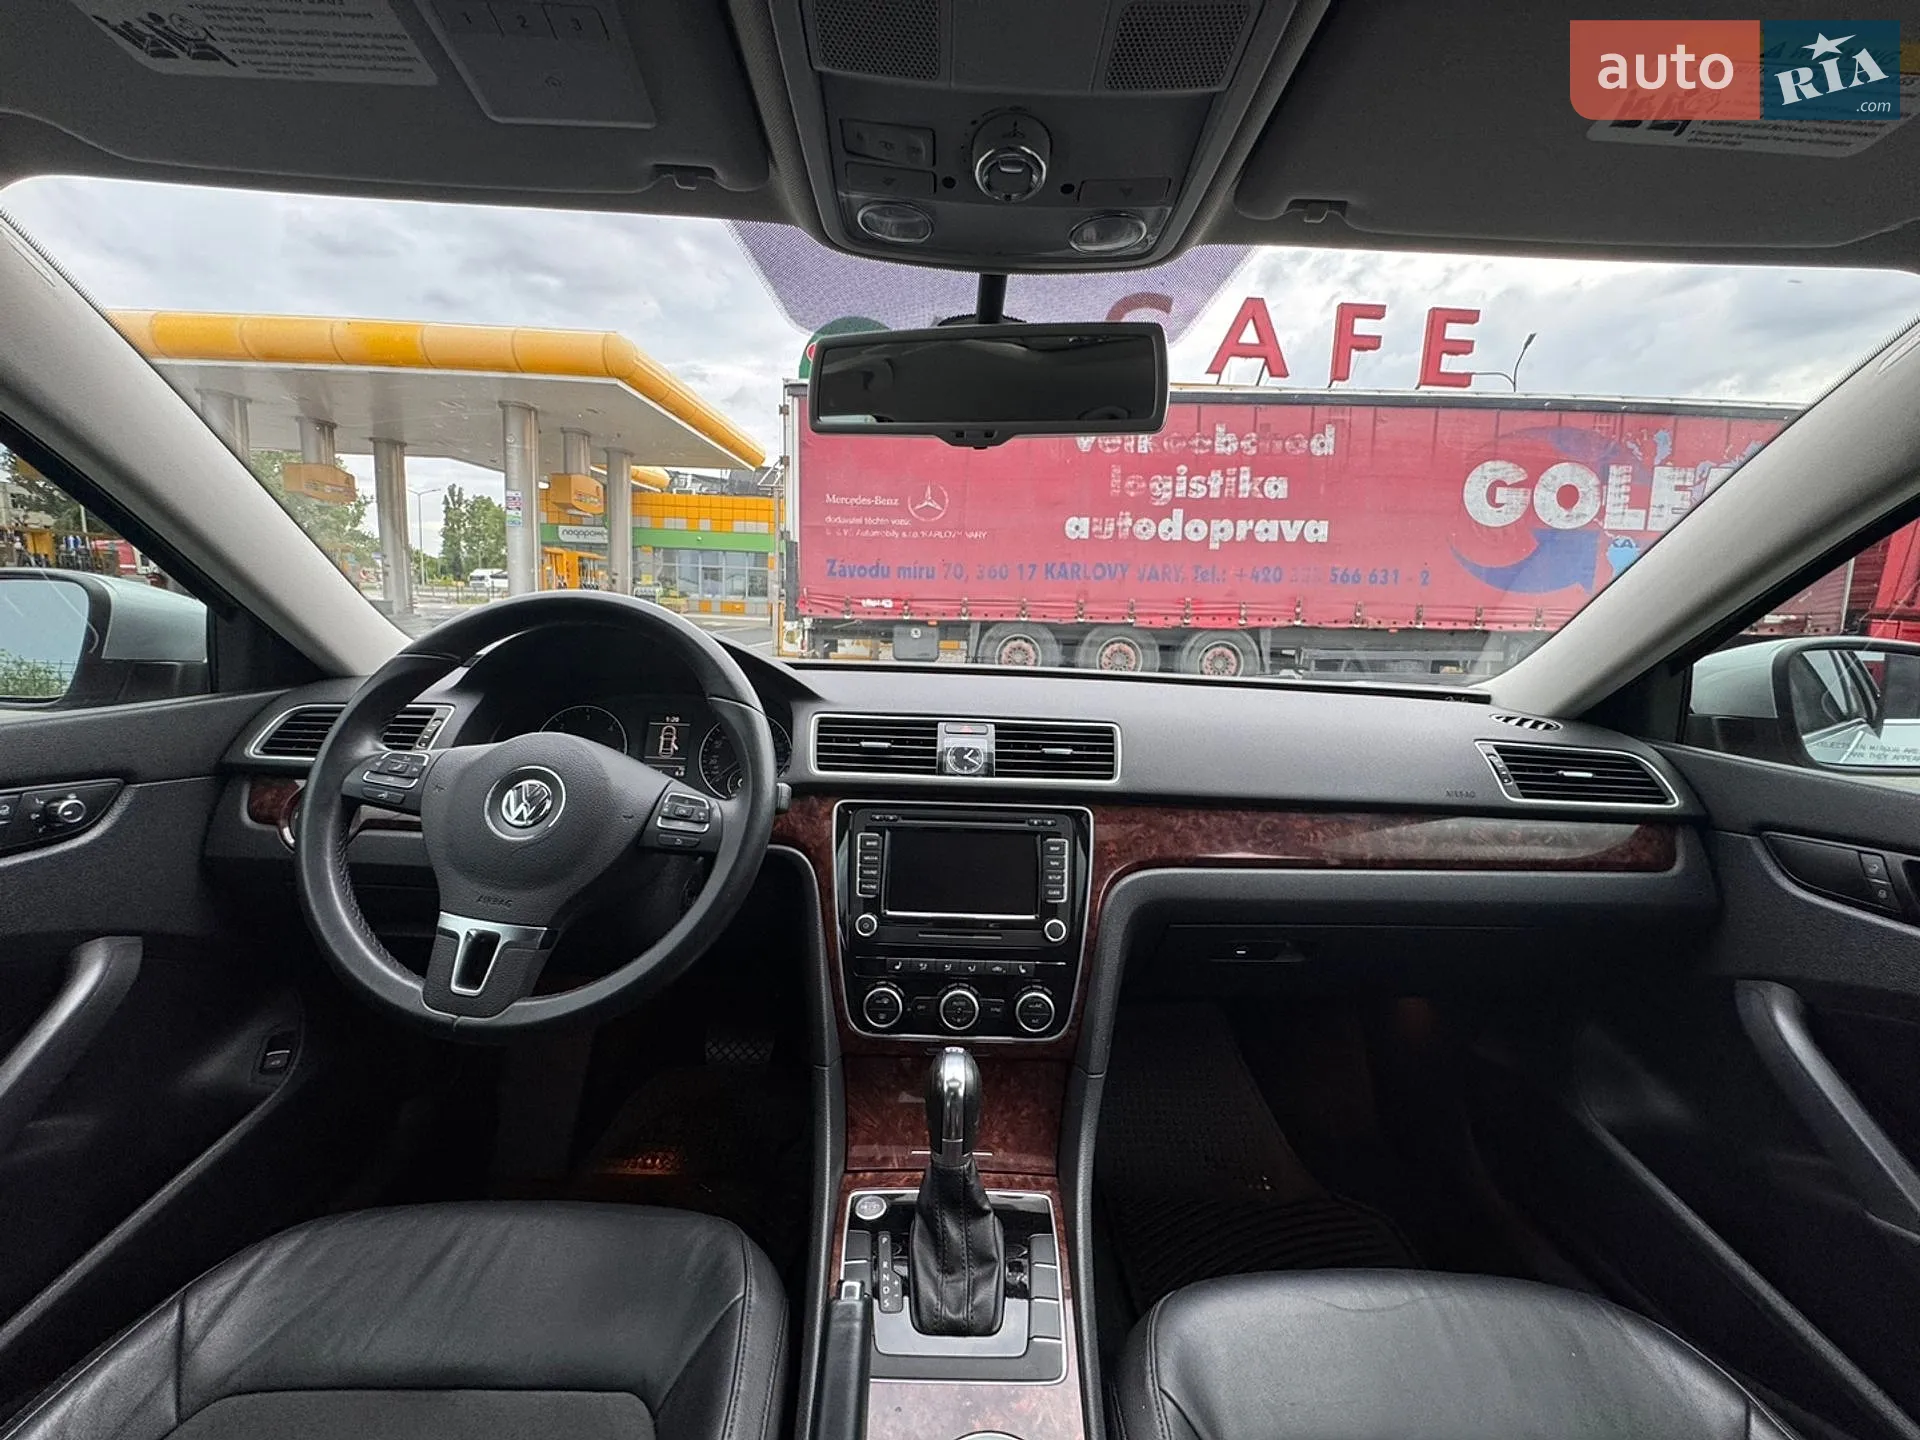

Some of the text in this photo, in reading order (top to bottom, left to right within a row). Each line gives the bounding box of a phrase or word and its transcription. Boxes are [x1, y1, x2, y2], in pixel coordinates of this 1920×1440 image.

[825, 493, 901, 507] Mercedes-Benz
[1110, 464, 1289, 506] logistika
[1064, 508, 1330, 550] autodoprava
[1017, 563, 1037, 582] 17
[1043, 562, 1129, 582] KARLOVY
[1328, 566, 1362, 585] 566
[1368, 568, 1399, 586] 631
